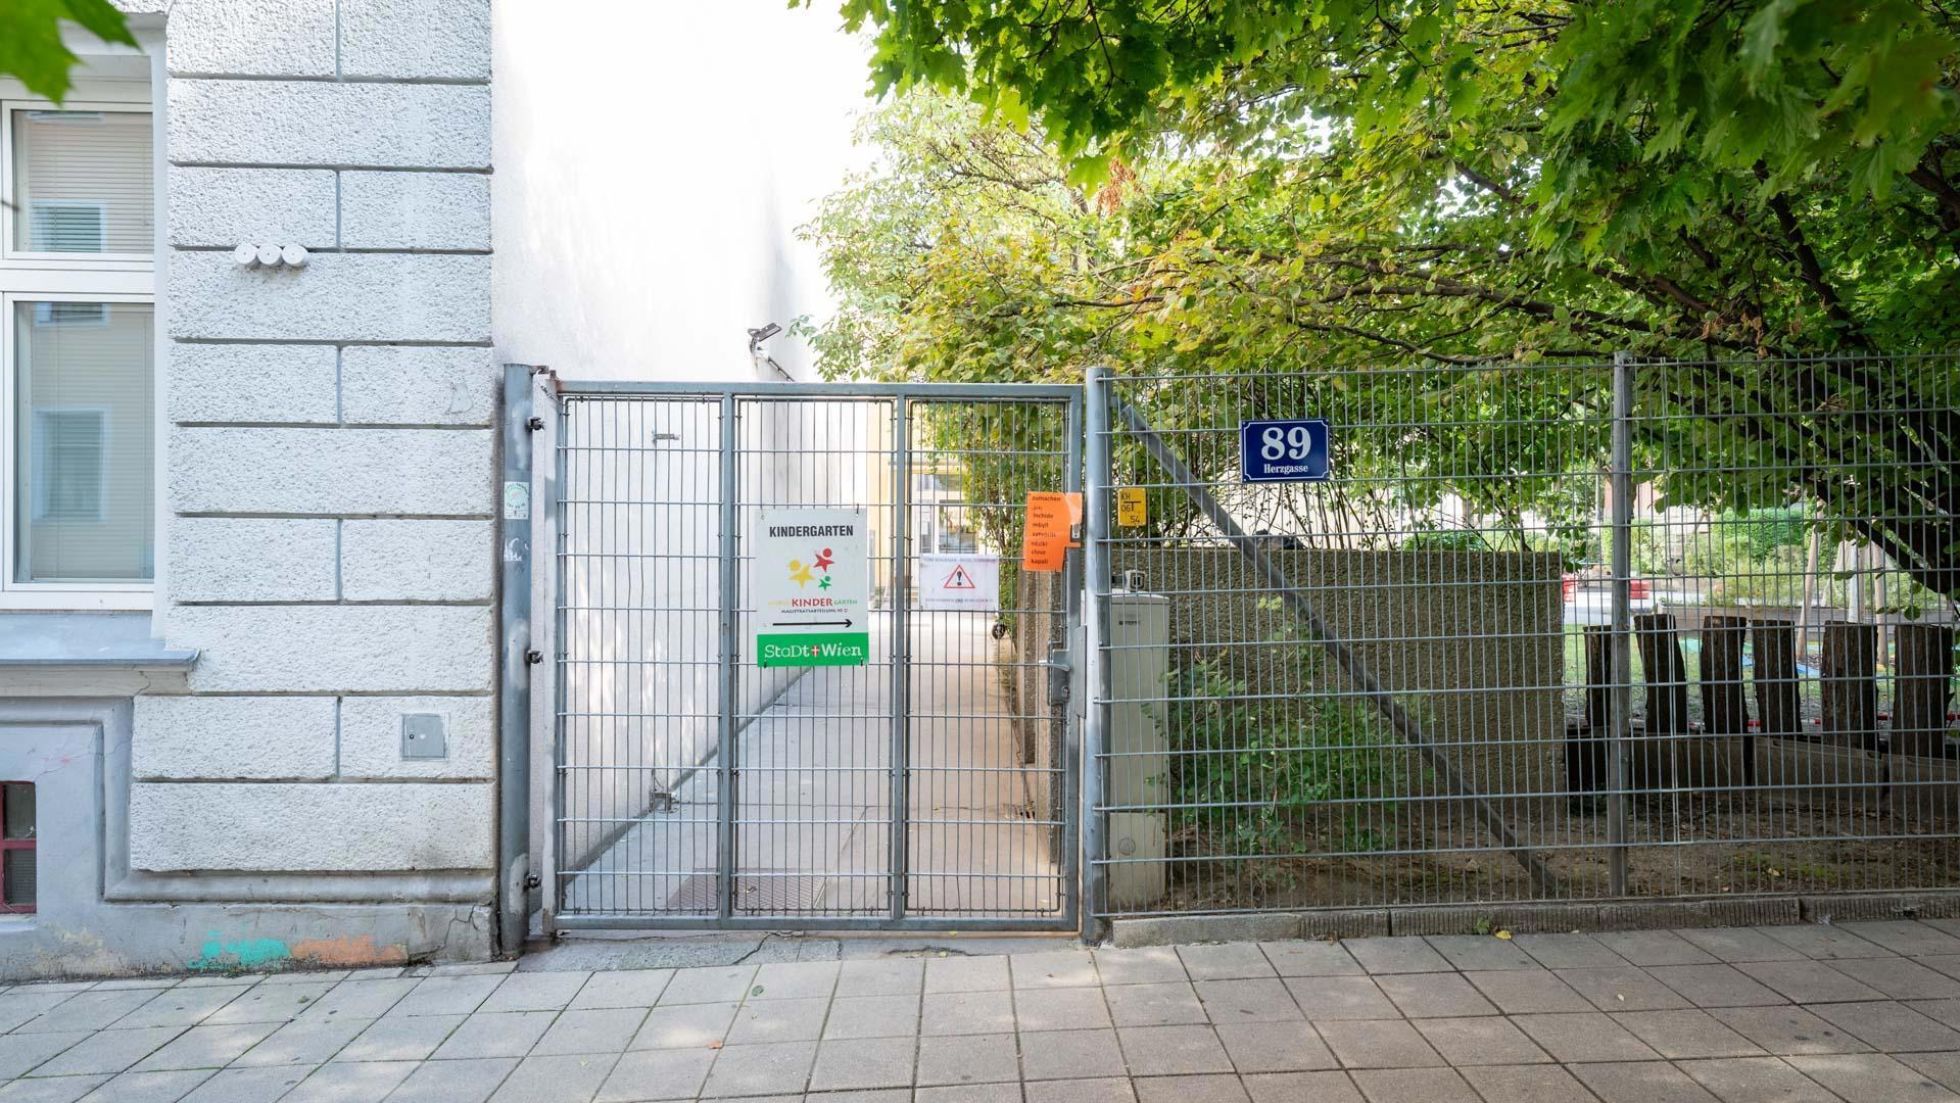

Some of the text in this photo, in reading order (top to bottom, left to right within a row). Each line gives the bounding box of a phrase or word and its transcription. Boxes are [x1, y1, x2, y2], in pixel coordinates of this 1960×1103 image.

[1261, 426, 1312, 460] 89
[1263, 463, 1309, 475] Herzgasse
[769, 525, 854, 538] KINDERGARTEN
[792, 597, 833, 608] KINDER
[821, 642, 862, 657] Wien
